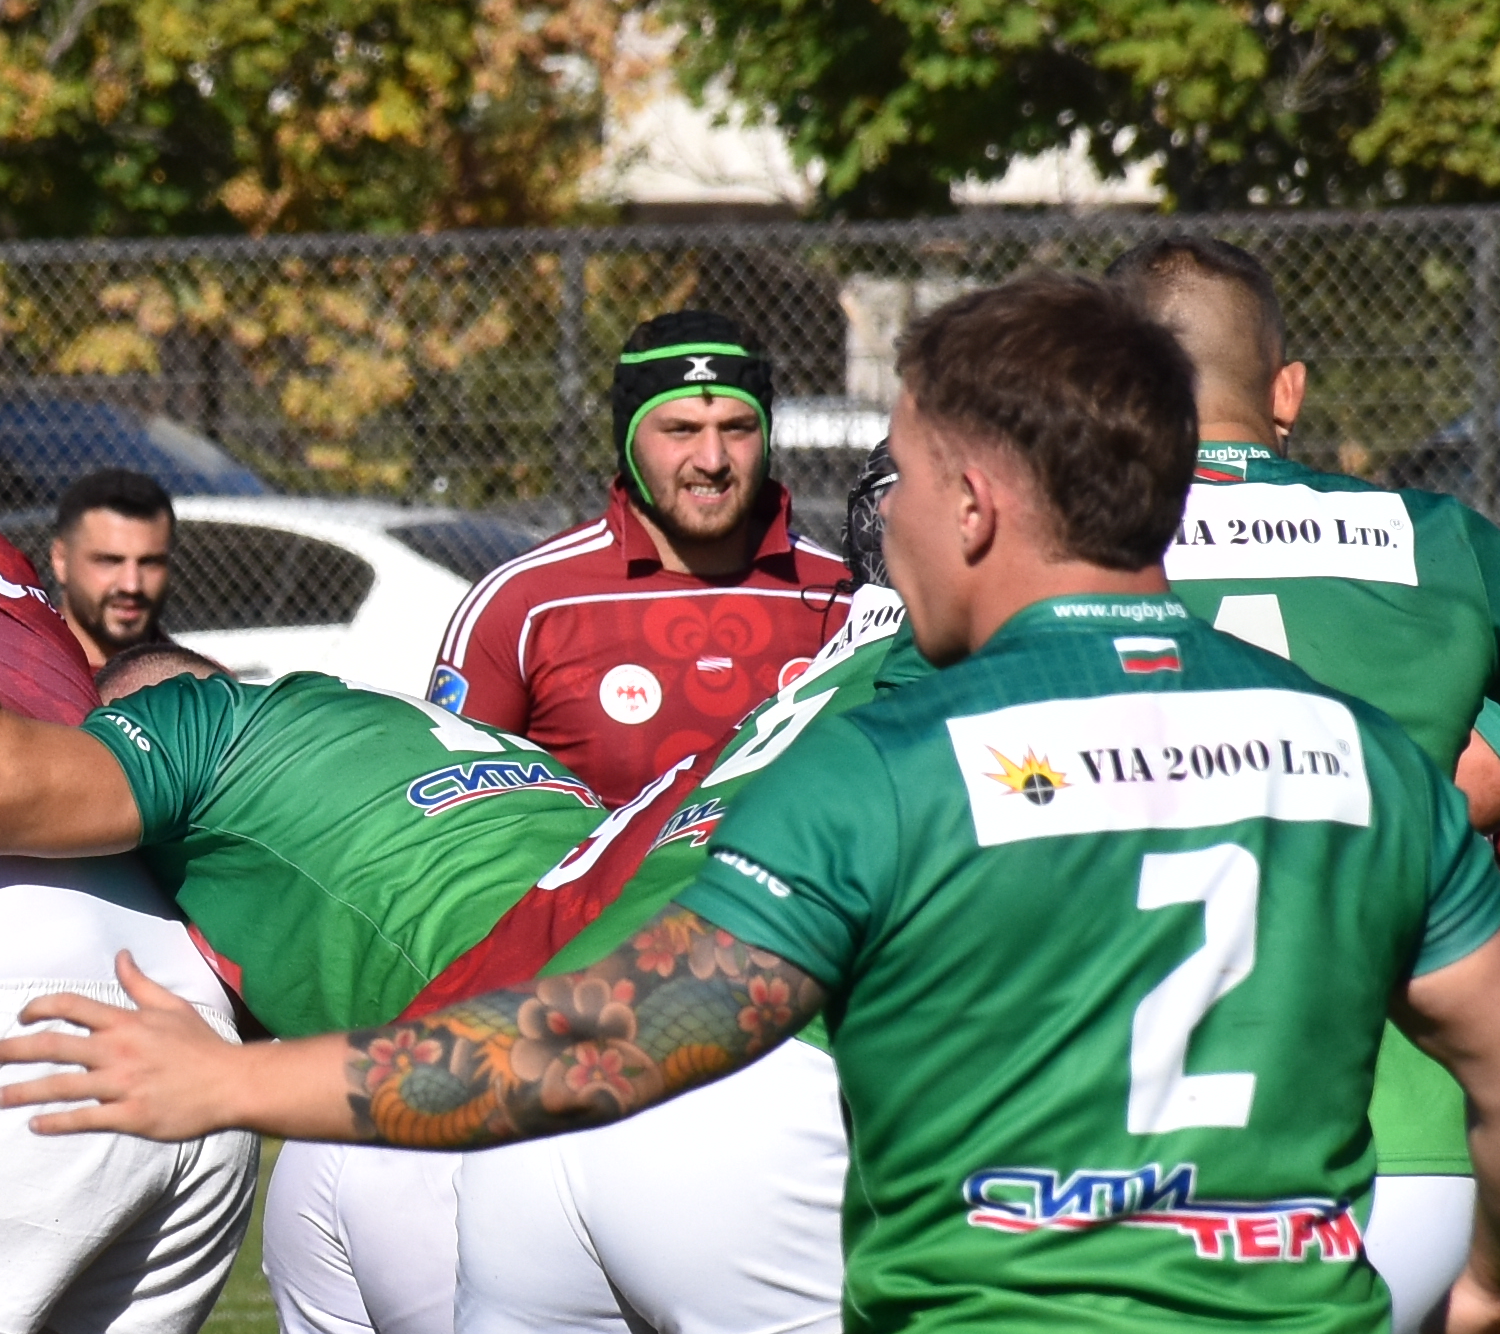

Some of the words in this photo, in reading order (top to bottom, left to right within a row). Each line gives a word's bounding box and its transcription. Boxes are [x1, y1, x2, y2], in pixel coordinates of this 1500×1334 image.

[1227, 518, 1321, 545] 2000
[1053, 600, 1188, 622] www.rugby.bg
[1077, 746, 1155, 784] VIA
[1162, 739, 1270, 781] 2000
[1127, 842, 1261, 1135] 2
